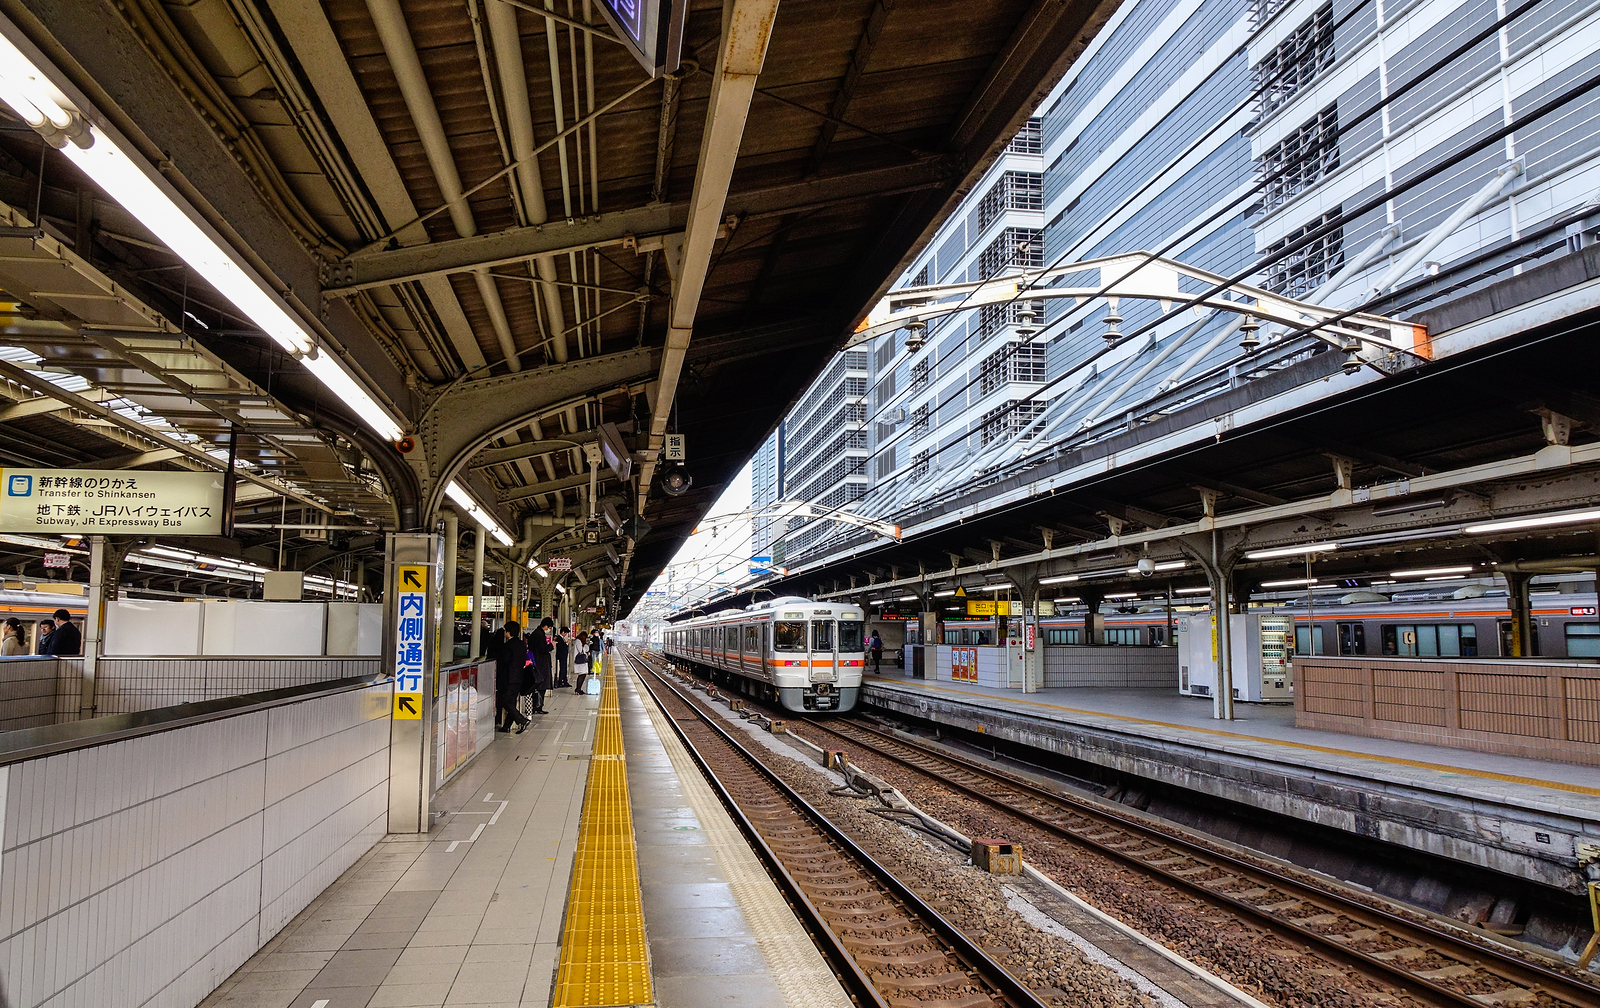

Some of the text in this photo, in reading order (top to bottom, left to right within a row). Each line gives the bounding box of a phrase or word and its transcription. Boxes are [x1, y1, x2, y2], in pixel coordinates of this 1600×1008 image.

[669, 436, 681, 458] 指示
[38, 476, 138, 490] 新幹線のりかえ
[38, 489, 156, 499] Transfer to Shinkansen
[36, 517, 182, 528] Subway, JR Expressway Bus
[396, 592, 424, 692] 内側通行
